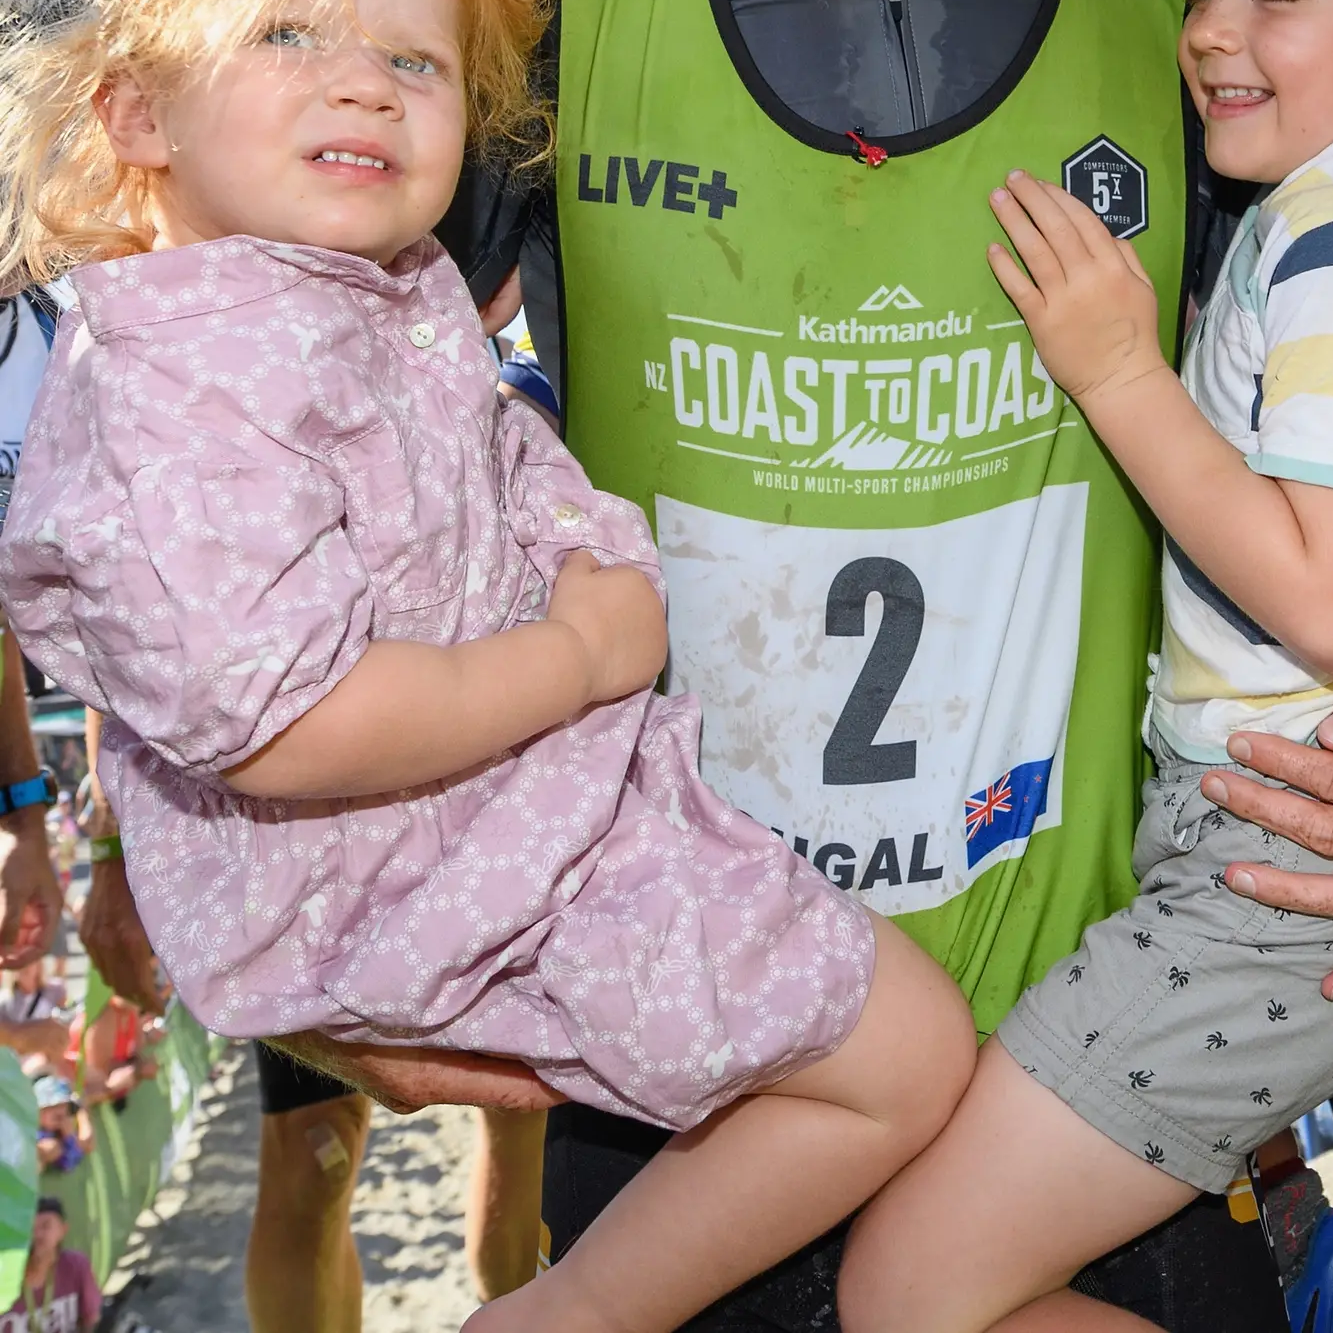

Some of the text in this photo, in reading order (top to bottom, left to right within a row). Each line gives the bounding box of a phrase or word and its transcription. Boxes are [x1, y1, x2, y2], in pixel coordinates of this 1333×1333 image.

[578, 153, 737, 219] LIVE+
[1083, 161, 1128, 173] COMPETITORS
[1103, 214, 1131, 224] MEMBER
[799, 310, 973, 345] Kathmandu
[645, 336, 1071, 447] NZ COAST TO COAS
[753, 456, 1010, 496] WORLD MULTI-SPORT CHAMPIONSHIPS
[822, 556, 926, 786] 2
